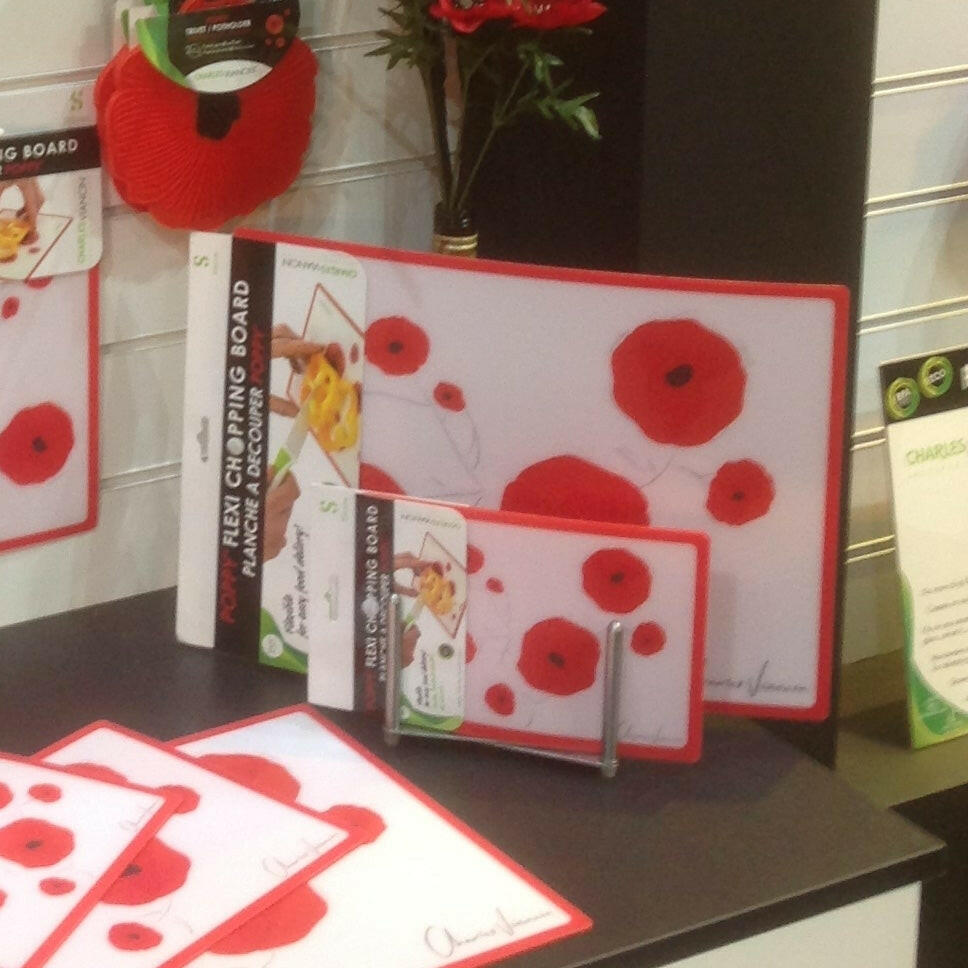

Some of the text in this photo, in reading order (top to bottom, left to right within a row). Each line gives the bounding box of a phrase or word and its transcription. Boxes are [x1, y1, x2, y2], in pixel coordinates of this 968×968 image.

[22, 138, 79, 160] BOARD
[230, 279, 250, 357] BOARD
[246, 386, 265, 478] DECOUPER
[245, 482, 260, 496] A
[222, 495, 241, 548] FLEXI
[241, 497, 260, 578] PLANCHE
[365, 504, 380, 554] BOARD
